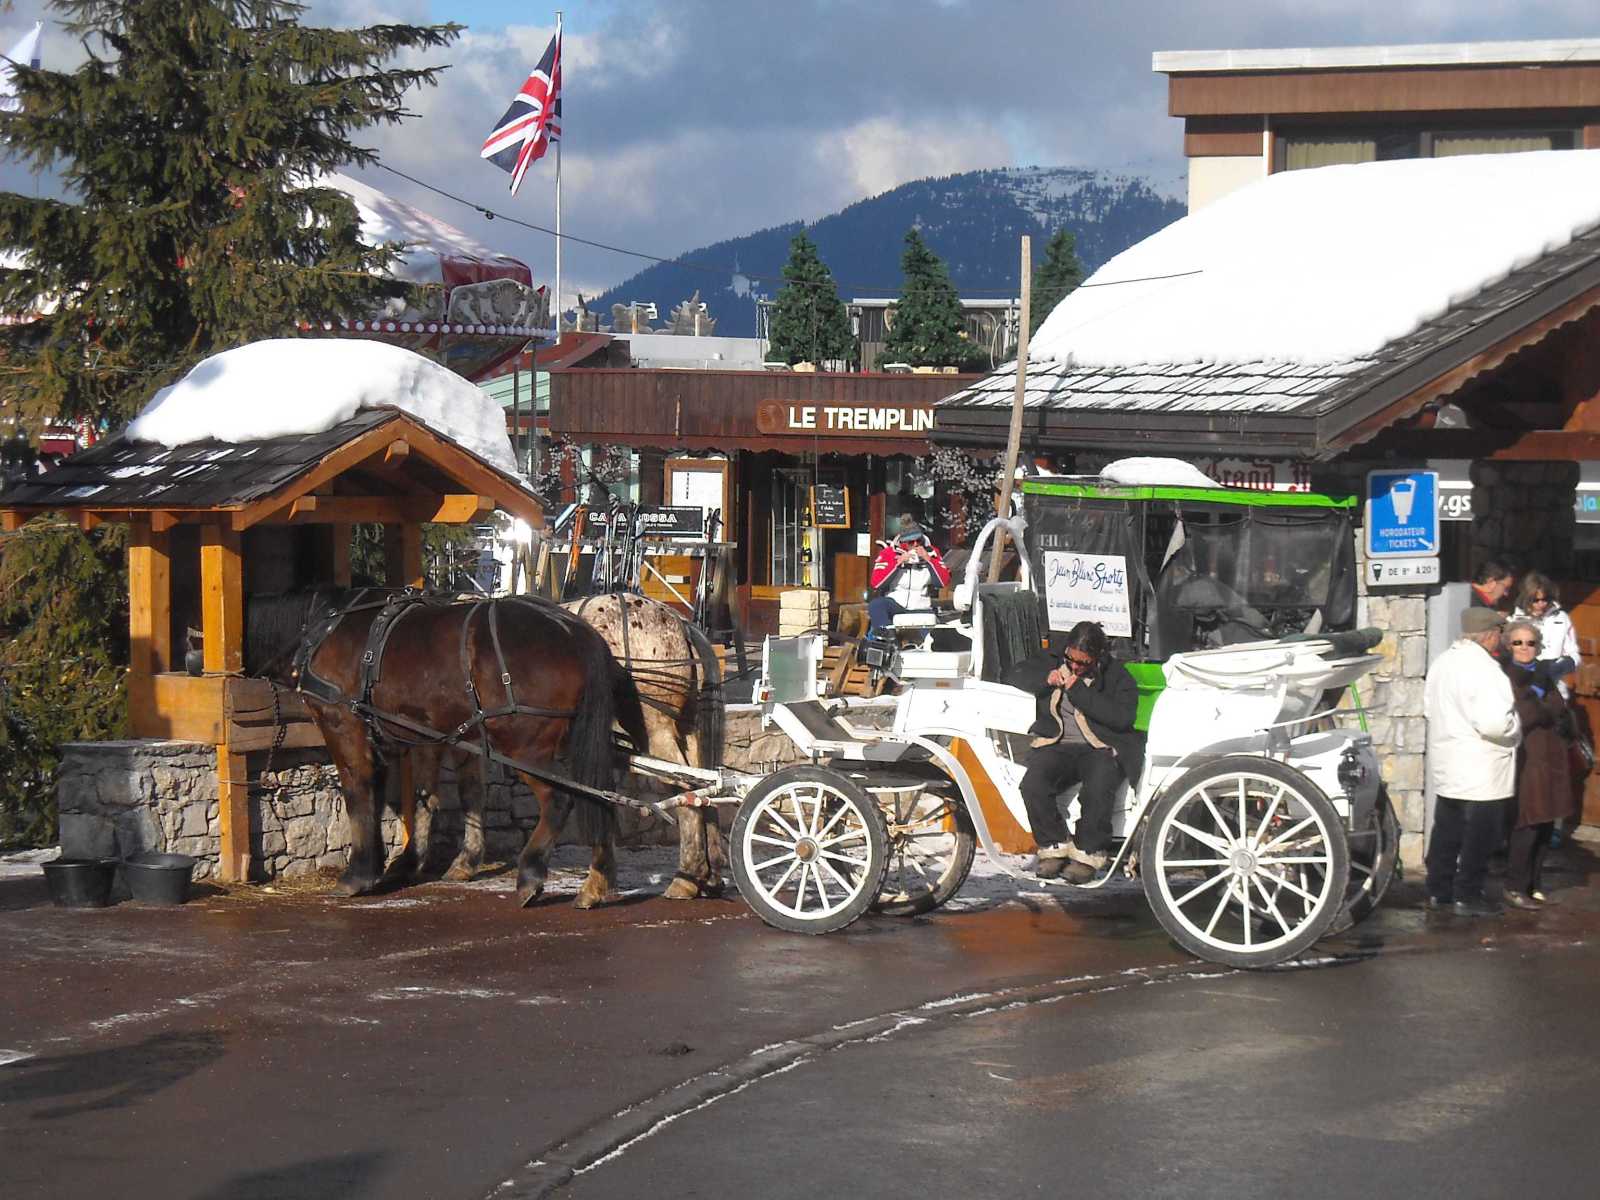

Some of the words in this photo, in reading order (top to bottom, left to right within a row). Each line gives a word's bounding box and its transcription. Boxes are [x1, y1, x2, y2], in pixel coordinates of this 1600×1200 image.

[789, 407, 816, 428] LE
[824, 407, 934, 431] TREMPLIN
[589, 512, 627, 522] CAA
[638, 513, 678, 523] OSSA
[1380, 527, 1425, 537] HORODATEUR
[1389, 539, 1417, 549] TICKETS
[1388, 568, 1399, 576] DE
[1092, 563, 1125, 592] Sports
